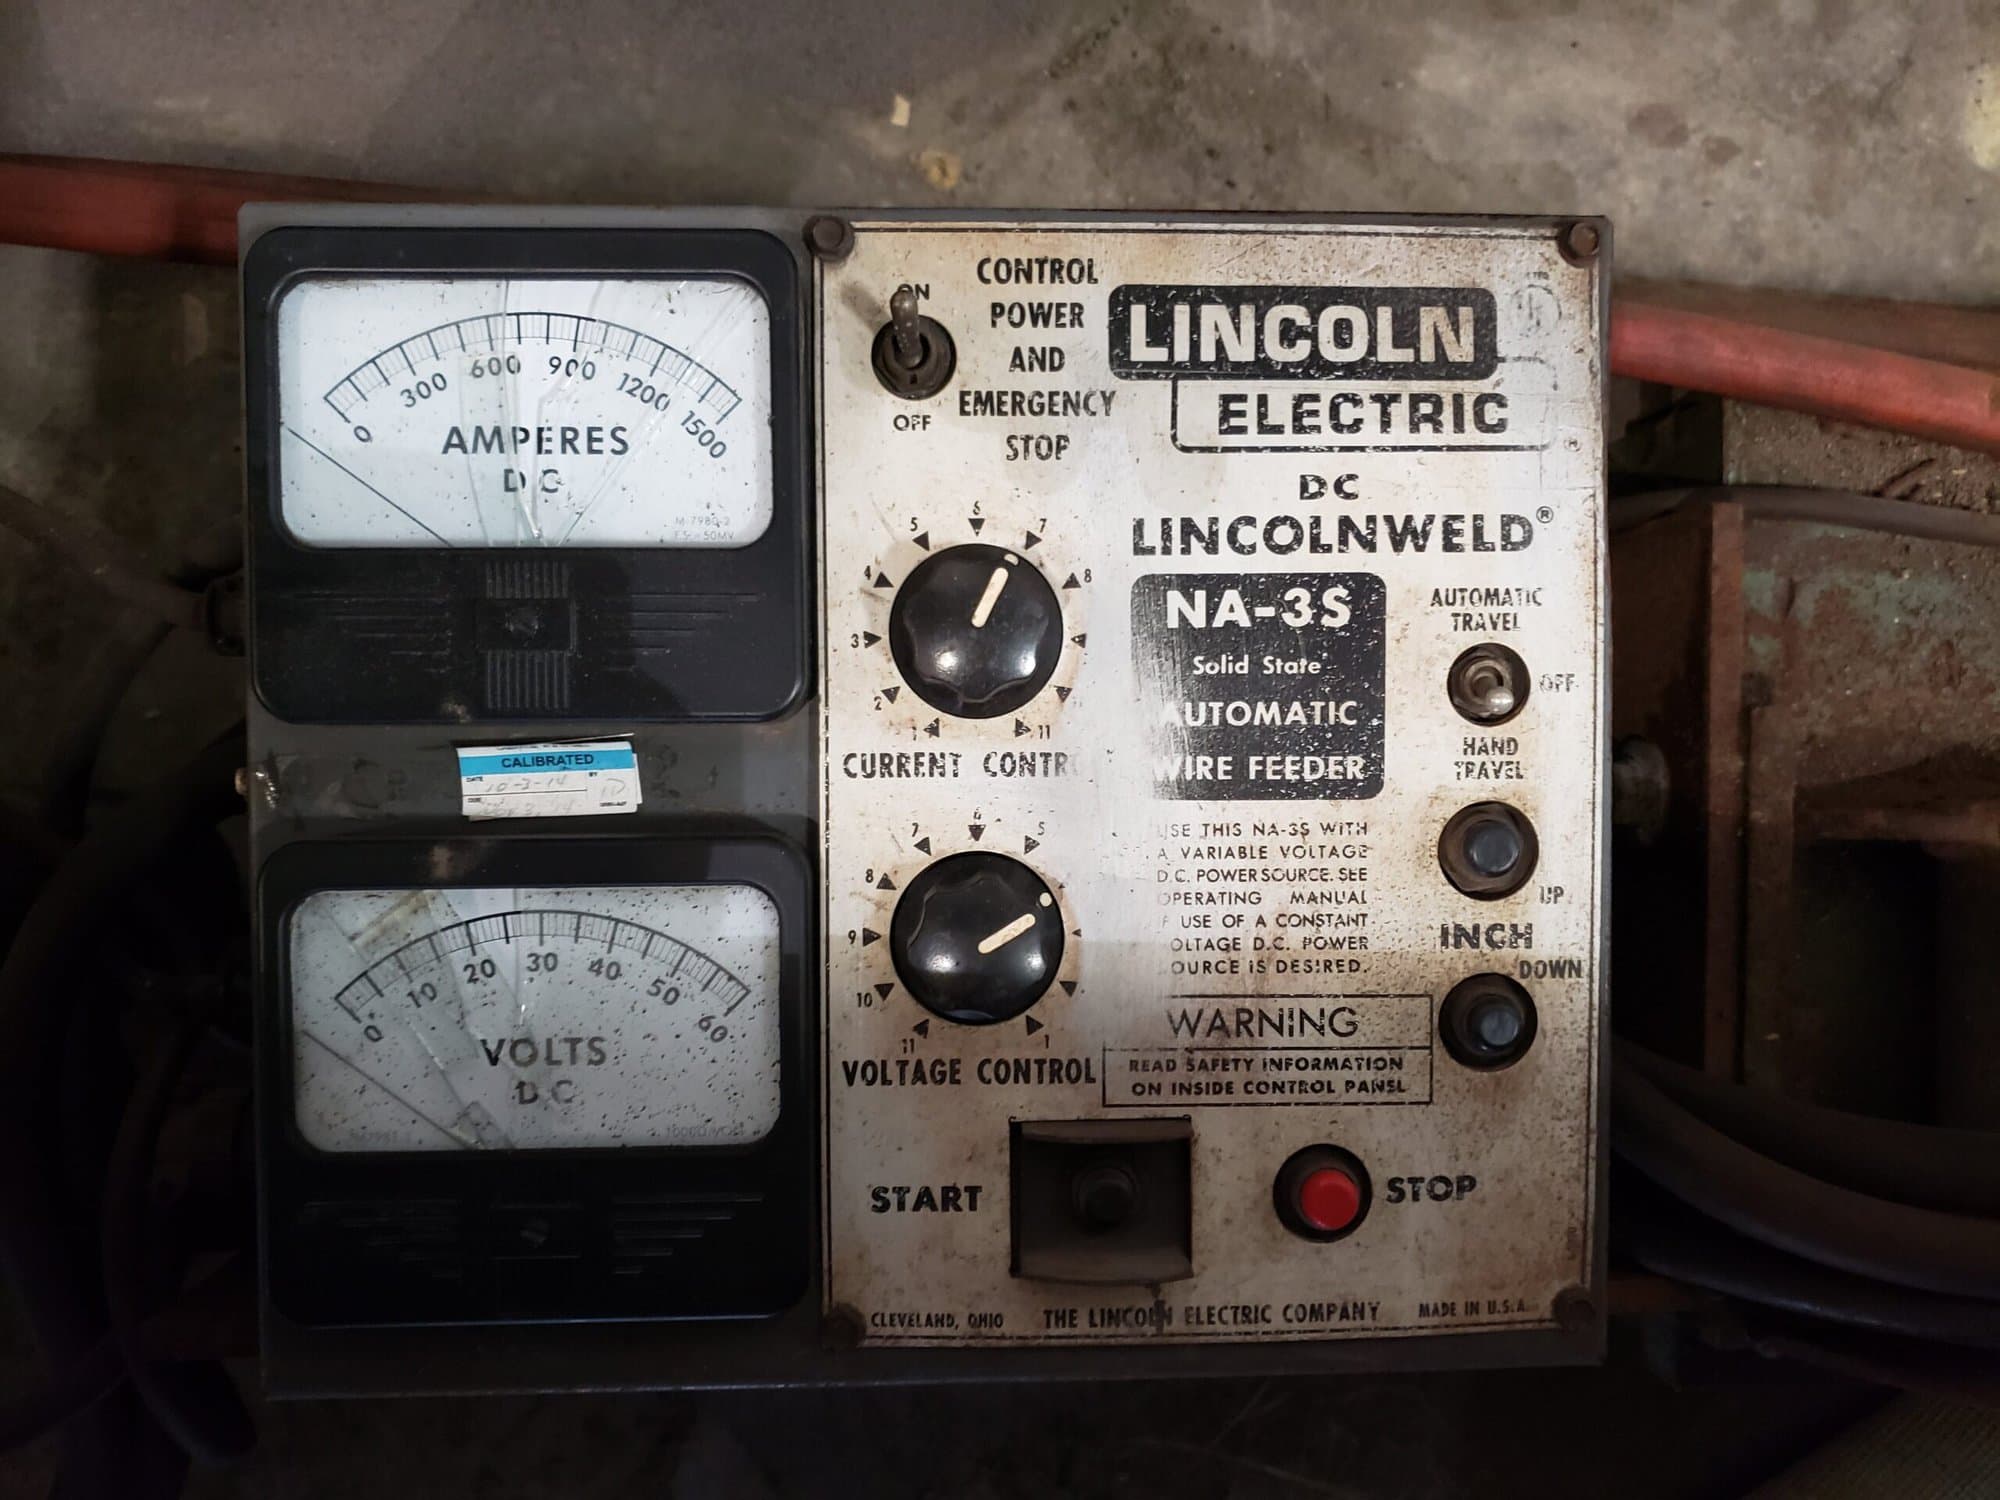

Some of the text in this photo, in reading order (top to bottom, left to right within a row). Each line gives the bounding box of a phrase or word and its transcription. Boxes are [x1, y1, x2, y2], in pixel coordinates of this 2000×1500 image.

[977, 258, 1098, 285] CONTROL
[991, 303, 1085, 328] POWER
[1130, 304, 1475, 363] LINCOLN
[471, 355, 521, 379] 600
[1009, 347, 1066, 372] AND
[549, 357, 596, 382] 900
[401, 372, 448, 409] 300
[616, 372, 671, 414] 1200
[959, 390, 1116, 417] EMERGENCY
[894, 415, 931, 431] OFF
[1218, 393, 1508, 435] ELECTRIC
[354, 425, 372, 443] 0
[442, 426, 629, 456] AMPERES
[682, 410, 727, 461] 1500
[1006, 434, 1070, 460] STOP
[1299, 473, 1359, 500] DC
[911, 517, 918, 531] 5
[1040, 518, 1047, 532] 7
[864, 566, 871, 580] 4
[1084, 569, 1092, 583] 8
[1431, 588, 1544, 607] AUTOMATIC
[1167, 587, 1351, 628] NA-3S
[1451, 613, 1520, 631] TRAVEL
[851, 634, 859, 648] 3
[1193, 655, 1321, 675] Solid State
[1539, 674, 1575, 692] OFF
[874, 696, 882, 710] 2
[1038, 725, 1050, 739] 11
[1463, 737, 1518, 756] HAND
[502, 754, 594, 768] CALIBRATED
[843, 752, 962, 779] CURRENT
[1249, 756, 1365, 780] FEEDER
[1454, 761, 1524, 780] TRAVEL
[912, 823, 919, 837] 7
[1038, 822, 1045, 836] 5
[1202, 823, 1242, 837] THIS
[1253, 822, 1310, 837] NA-3S
[1319, 822, 1368, 836] WITH
[1158, 846, 1368, 860] A VARIABLE VOLTAGE
[866, 869, 873, 883] 8
[1197, 869, 1257, 882] POWER
[1261, 868, 1334, 882] SOURCE.
[1338, 868, 1368, 882] SEE
[1158, 891, 1367, 906] OPERATING MANUAL
[1540, 886, 1564, 904] UP
[1181, 915, 1212, 928] USE
[1222, 914, 1245, 928] OF
[1255, 915, 1267, 928] A
[1276, 914, 1368, 928] CONSTANT
[848, 931, 856, 944] 9
[1253, 937, 1290, 950] D.C.
[1303, 936, 1369, 950] POWER
[1440, 923, 1533, 950] INCH
[463, 959, 496, 984] 20
[526, 952, 558, 973] 30
[588, 957, 621, 981] 40
[1249, 960, 1266, 973] IS
[1276, 959, 1368, 973] DESIRED.
[1519, 960, 1582, 979] DOWN
[408, 983, 437, 1008] 10
[646, 977, 679, 1006] 50
[857, 993, 872, 1007] 10
[698, 1014, 728, 1044] 60
[1166, 1006, 1359, 1038] WARNING
[364, 1024, 382, 1043] 0
[480, 1037, 607, 1067] VOLTS
[902, 1039, 914, 1053] 11
[842, 1058, 1096, 1086] VOLTAGE CONTROL
[1129, 1056, 1403, 1073] READ SAFETY INFORMATION
[1132, 1079, 1406, 1096] ON INSIDE CONTROL PANEL
[1386, 1175, 1477, 1203] STOP
[871, 1186, 983, 1213] START
[1044, 1310, 1078, 1328] THE
[1184, 1304, 1272, 1326] ELECTRIC
[1284, 1302, 1381, 1323] COMPANY
[1419, 1303, 1457, 1318] MADE
[1465, 1301, 1479, 1316] IN
[871, 1312, 1004, 1330] CLEVELAND, OHIO
